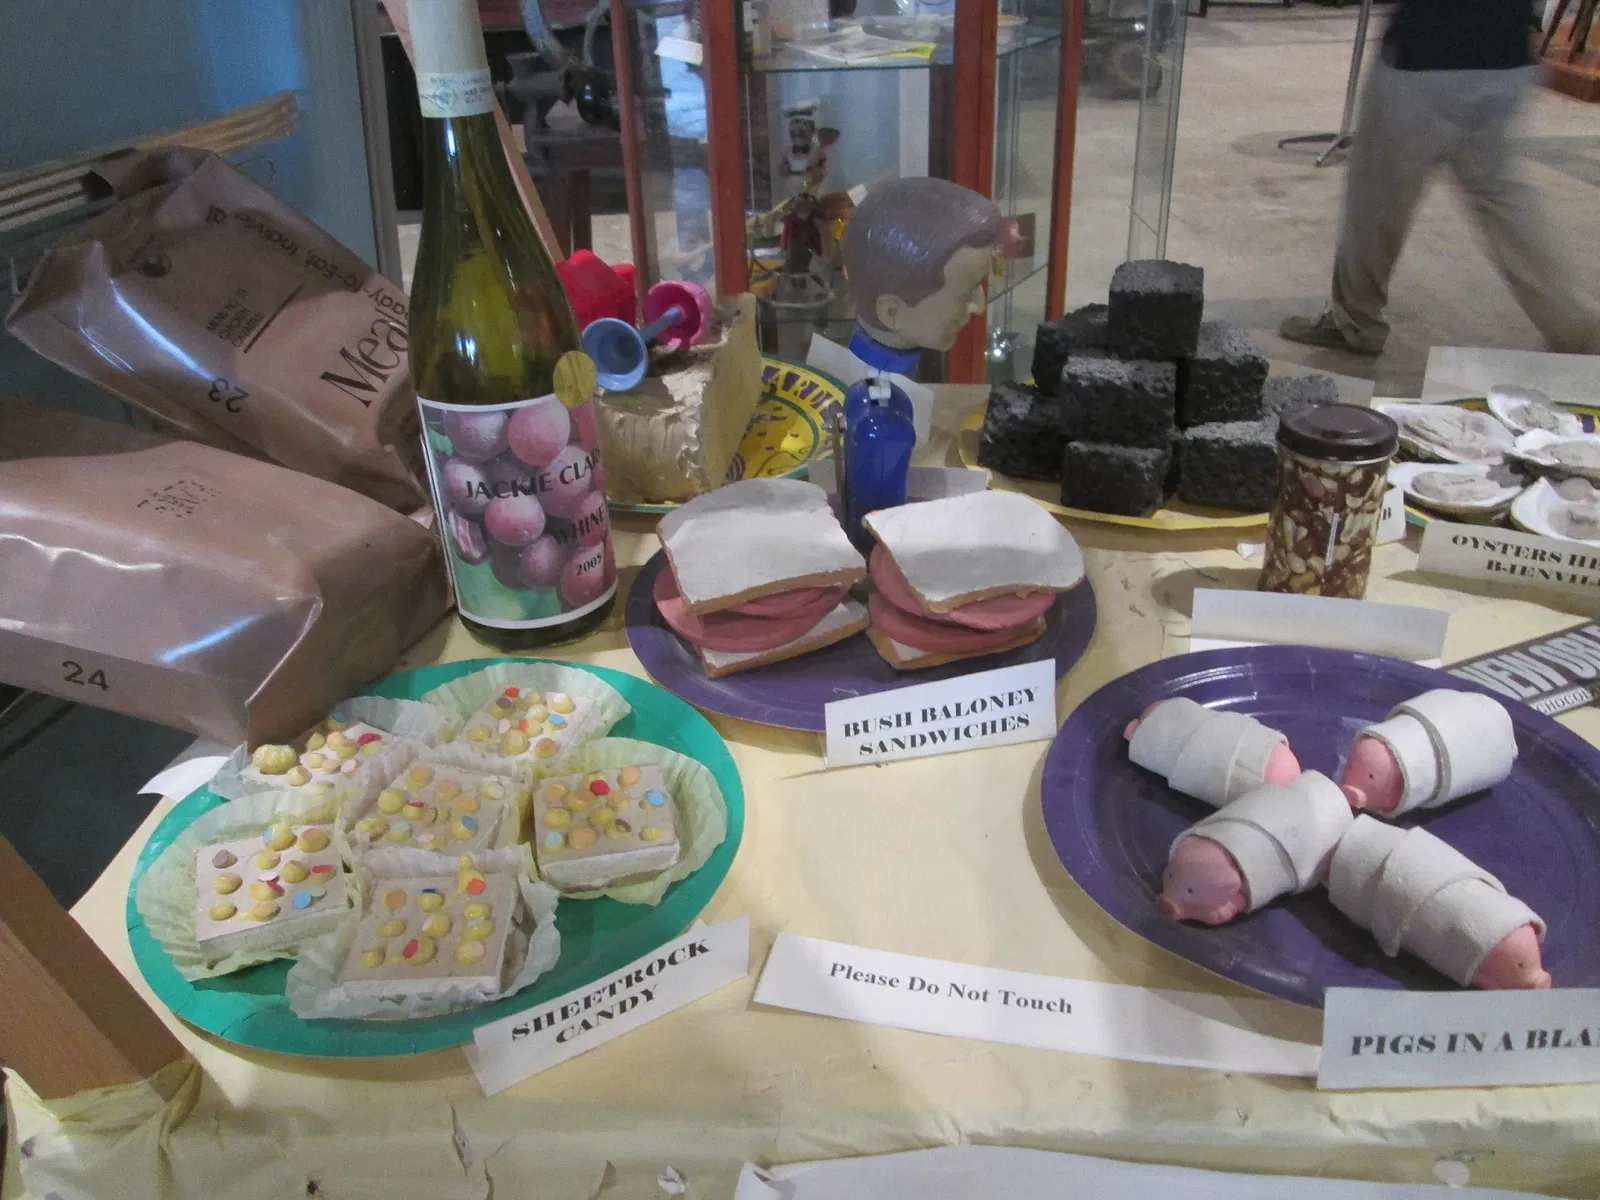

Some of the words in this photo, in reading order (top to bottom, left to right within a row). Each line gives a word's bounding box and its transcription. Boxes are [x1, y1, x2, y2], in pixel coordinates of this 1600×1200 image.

[208, 377, 250, 413] 23
[465, 470, 555, 500] JACKIE
[1452, 534, 1562, 564] OYSTERS
[62, 660, 111, 692] 24
[843, 710, 913, 738] BUSH
[921, 686, 1038, 723] BALONEY
[859, 713, 1030, 757] SANDWICHES
[511, 938, 710, 1042] SHEETROCK
[829, 961, 900, 988] Please
[908, 976, 940, 995] Do
[948, 982, 989, 1003] Not
[998, 989, 1073, 1015] Touch
[556, 984, 659, 1044] CANDY
[1351, 1033, 1437, 1055] PIGS
[1446, 1031, 1489, 1053] IN
[1494, 1031, 1517, 1051] A
[1525, 1025, 1600, 1050] BLA
